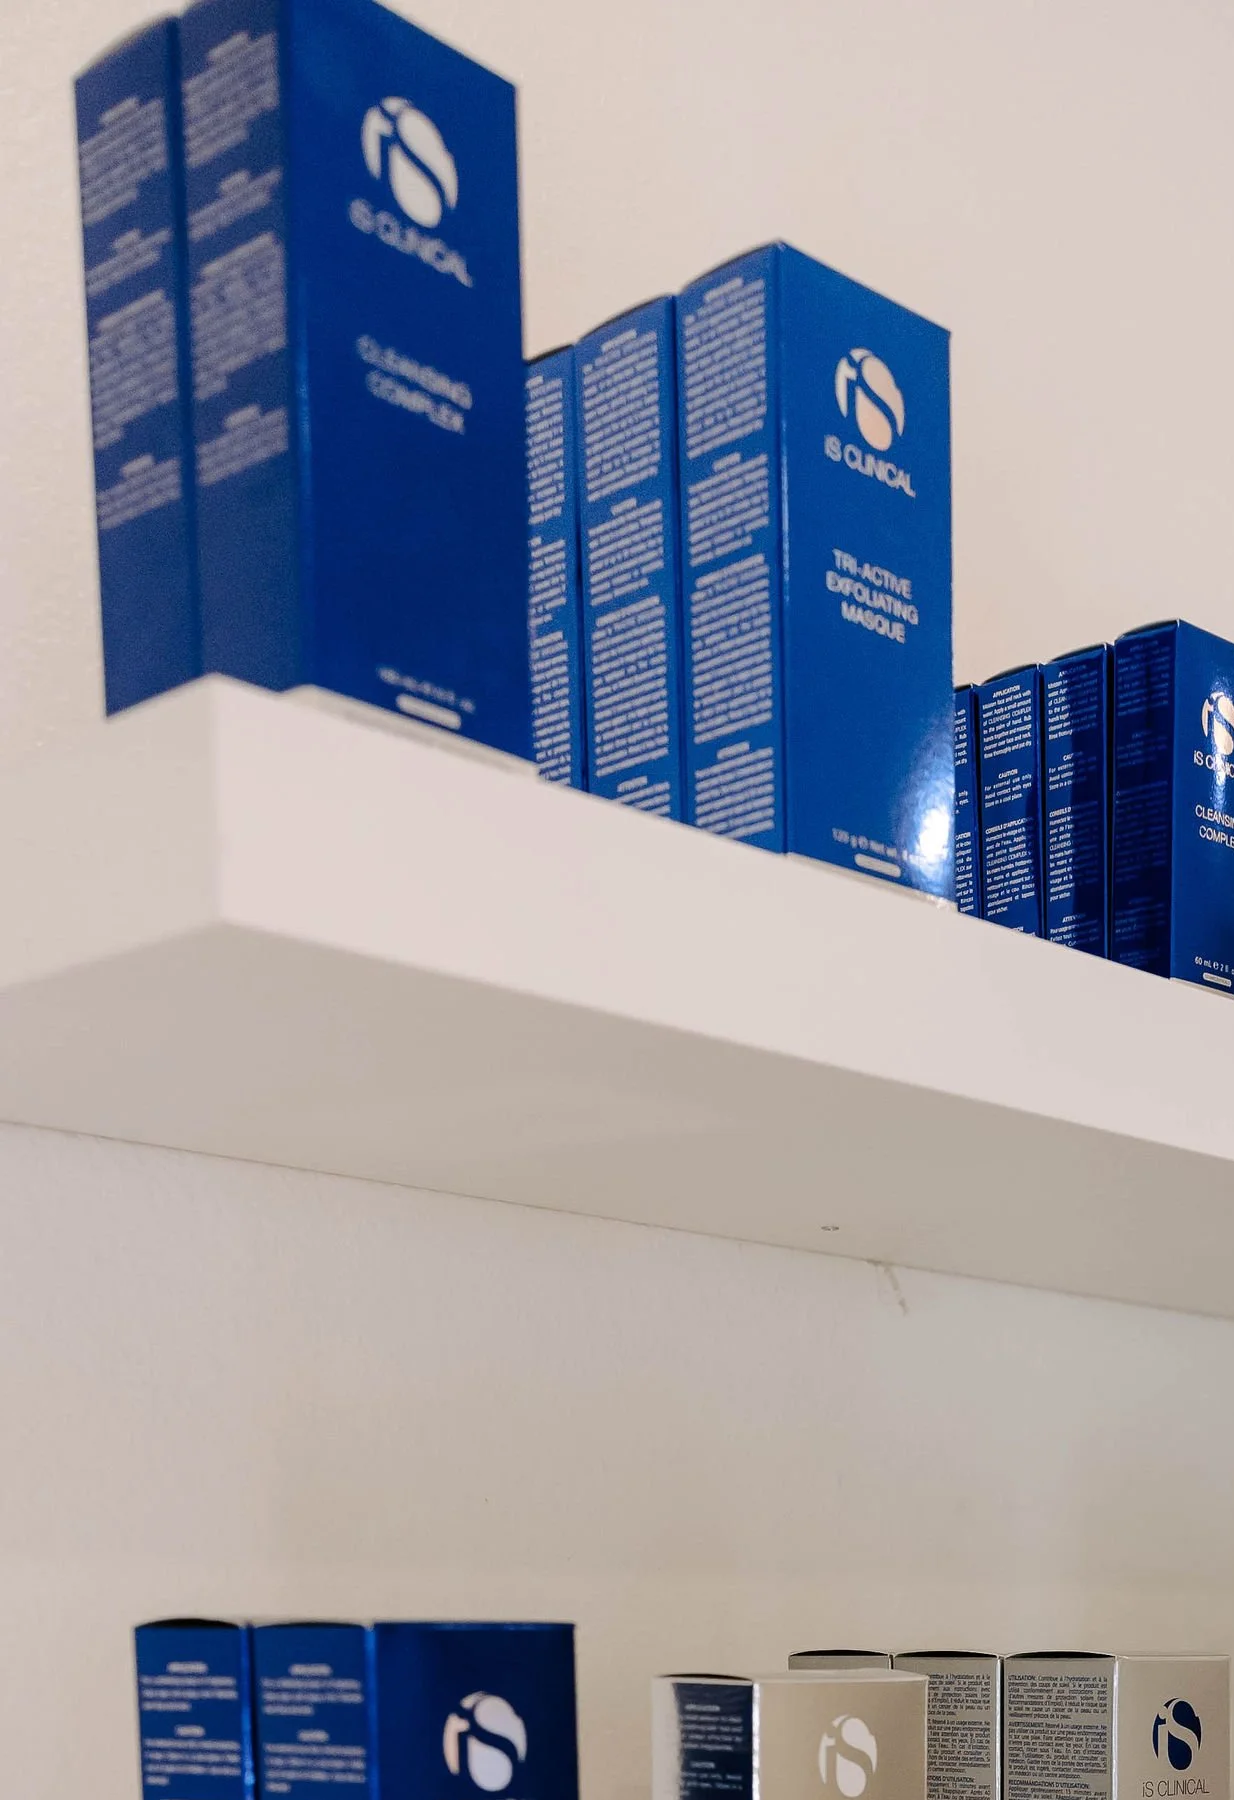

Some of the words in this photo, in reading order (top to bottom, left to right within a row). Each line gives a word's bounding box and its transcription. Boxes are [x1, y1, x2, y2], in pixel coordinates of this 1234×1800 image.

[843, 443, 917, 499] CLINICAL
[832, 547, 913, 601] TRI-ACTIVE
[825, 570, 919, 626] EXFOLIATING
[841, 600, 907, 645] MASQUE
[992, 685, 1021, 699] APPLICATION
[998, 769, 1018, 780] CAUTION
[1194, 956, 1203, 966] 60
[1142, 1781, 1155, 1798] iS
[1157, 1778, 1211, 1798] CLINICAL
